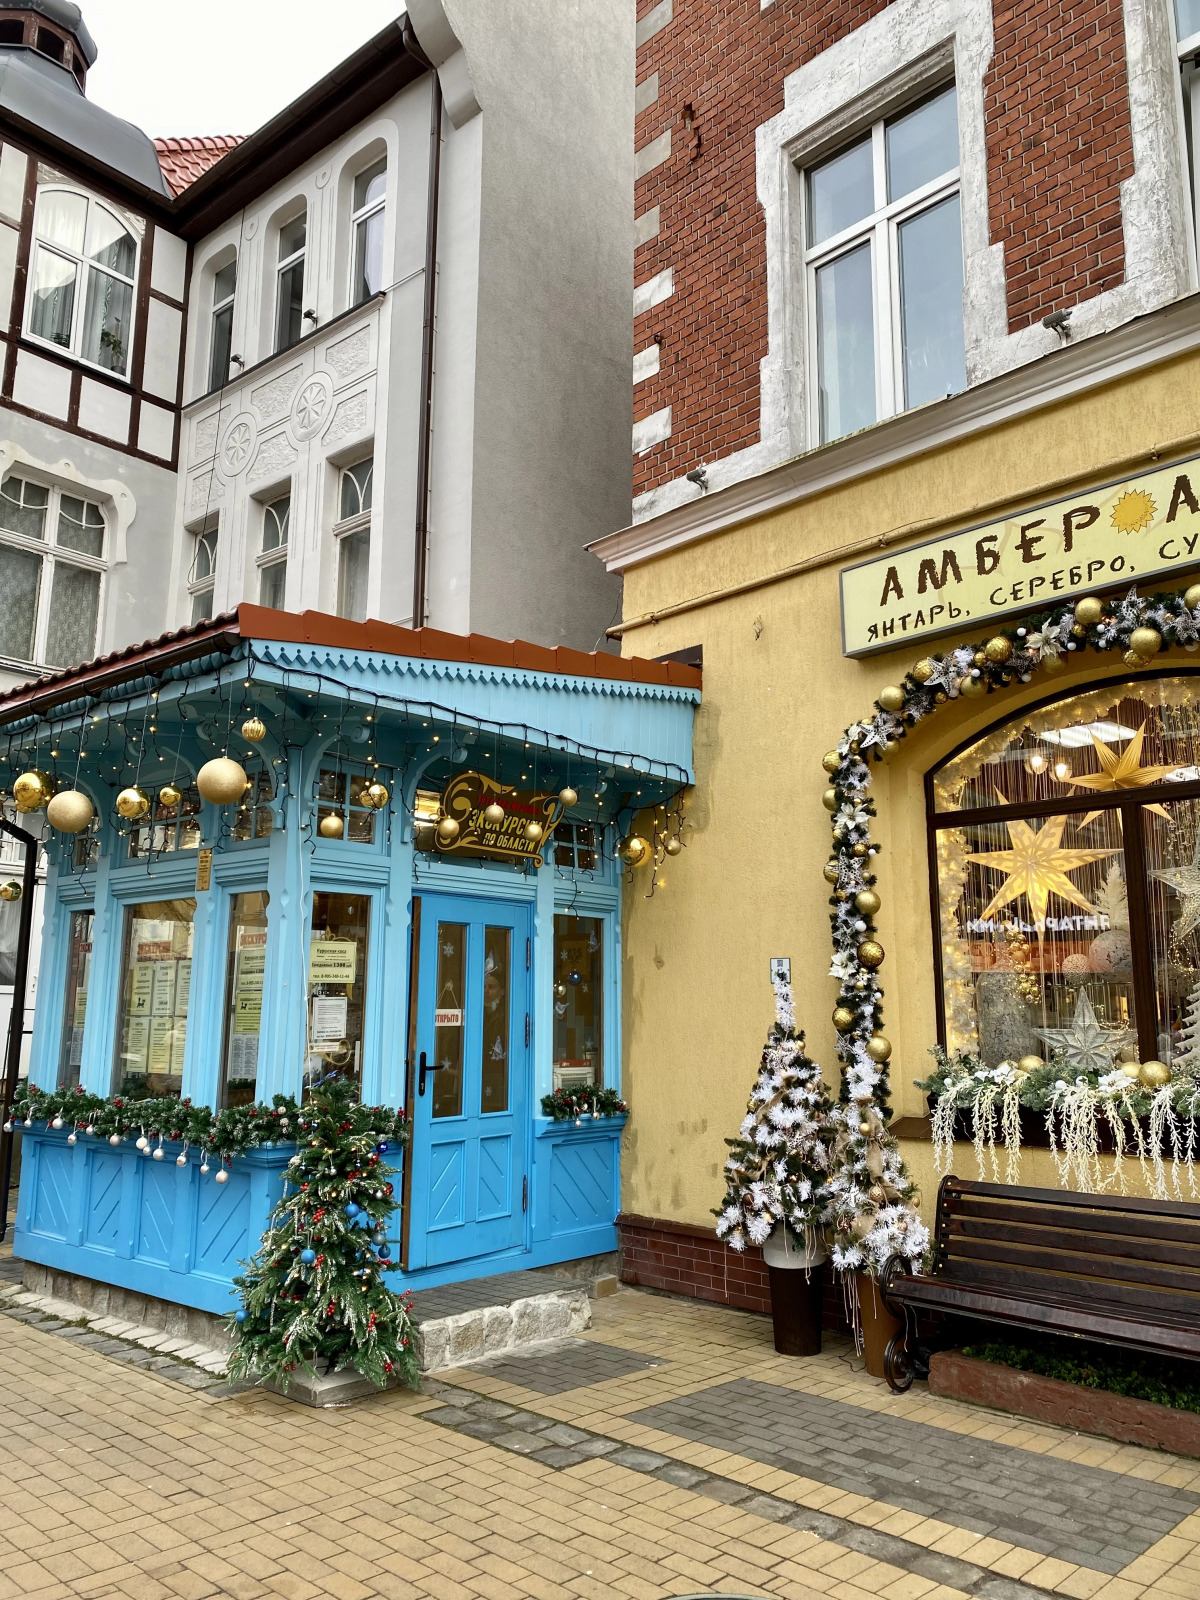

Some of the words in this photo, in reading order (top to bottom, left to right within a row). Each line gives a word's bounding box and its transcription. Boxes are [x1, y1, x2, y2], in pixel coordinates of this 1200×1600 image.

[880, 505, 1101, 606] АМБЕР
[867, 601, 971, 642] ЯНТАРЬ,
[989, 554, 1135, 606] СЕРЕБРО,
[468, 809, 543, 835] ЭКУРС
[482, 832, 497, 846] ПО
[496, 834, 536, 852] ОБЛАСТИ
